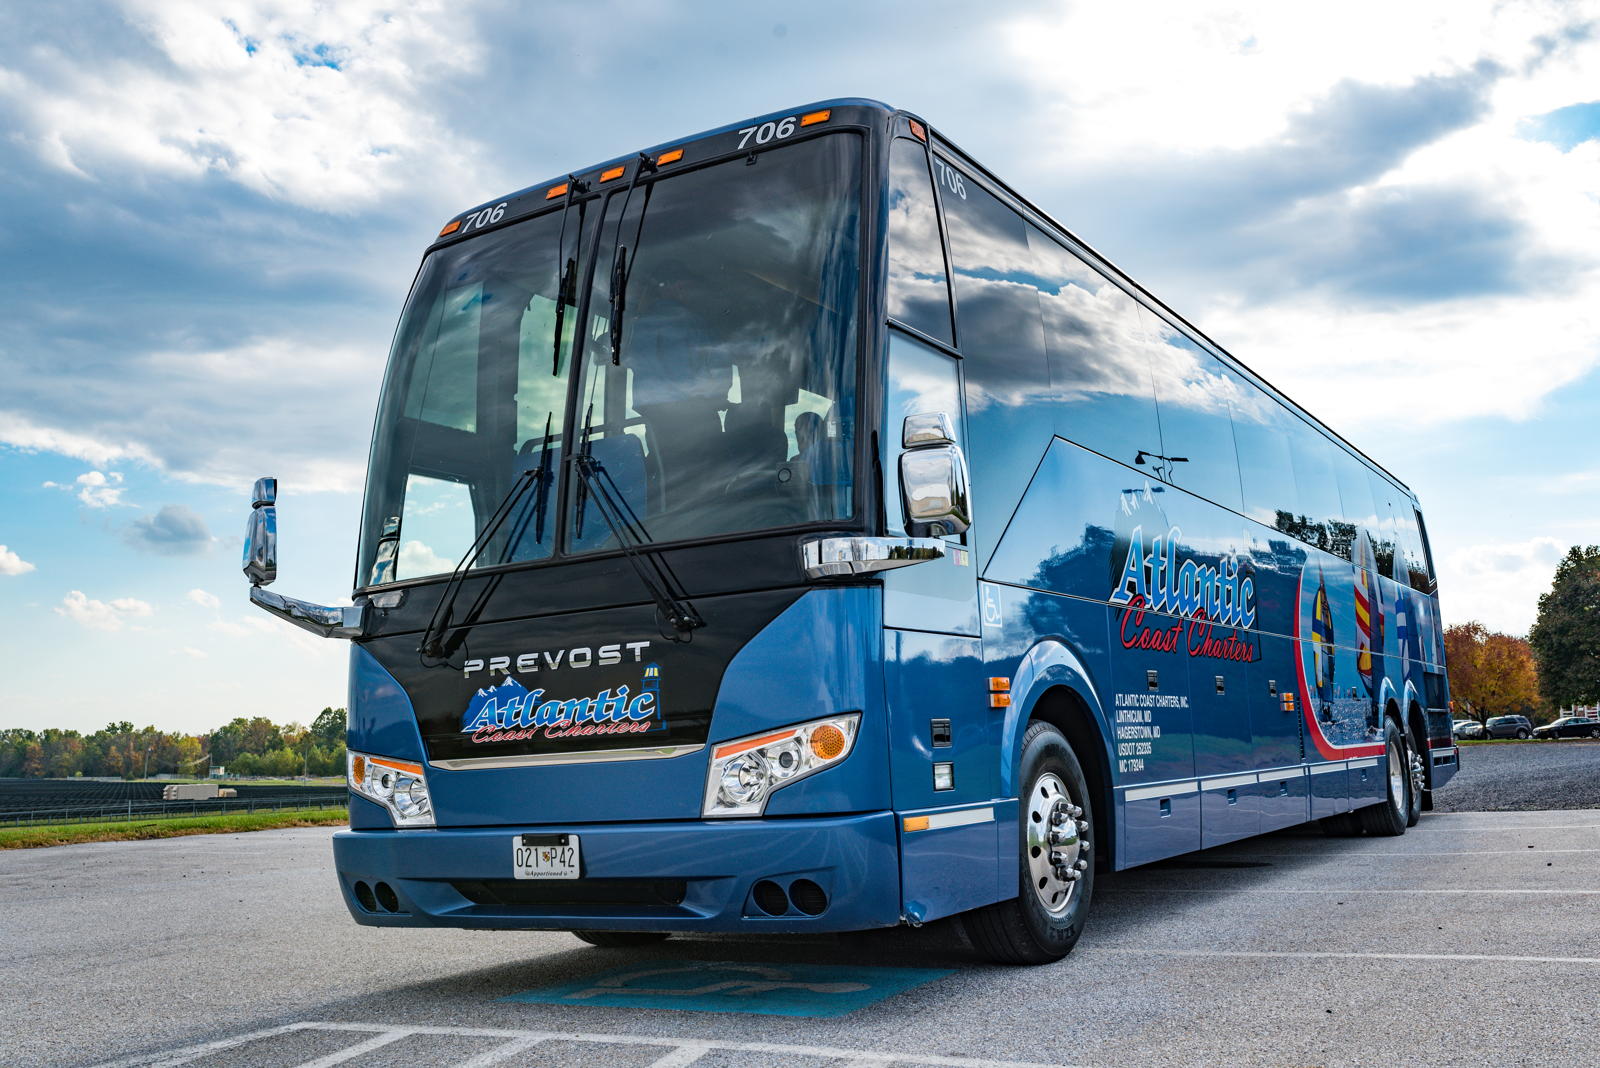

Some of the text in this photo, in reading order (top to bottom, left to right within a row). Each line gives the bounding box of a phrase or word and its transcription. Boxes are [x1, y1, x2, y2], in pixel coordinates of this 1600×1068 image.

[737, 116, 796, 150] 706
[934, 158, 967, 201] 706
[462, 202, 507, 234] 706
[1109, 525, 1256, 629] Atlantic
[1120, 594, 1254, 663] Coast Charters
[463, 641, 651, 679] PREVOST
[461, 684, 656, 733] Atlantic
[1115, 693, 1140, 707] ATLANTIC
[1140, 694, 1156, 708] COAST
[1156, 695, 1180, 710] CHARTERS,
[1144, 710, 1152, 723] MD
[471, 719, 652, 744] Coast Charters
[1152, 725, 1161, 739] MD
[1117, 742, 1136, 757] USDOT
[1119, 759, 1128, 773] MC
[516, 847, 575, 868] 021 P42
